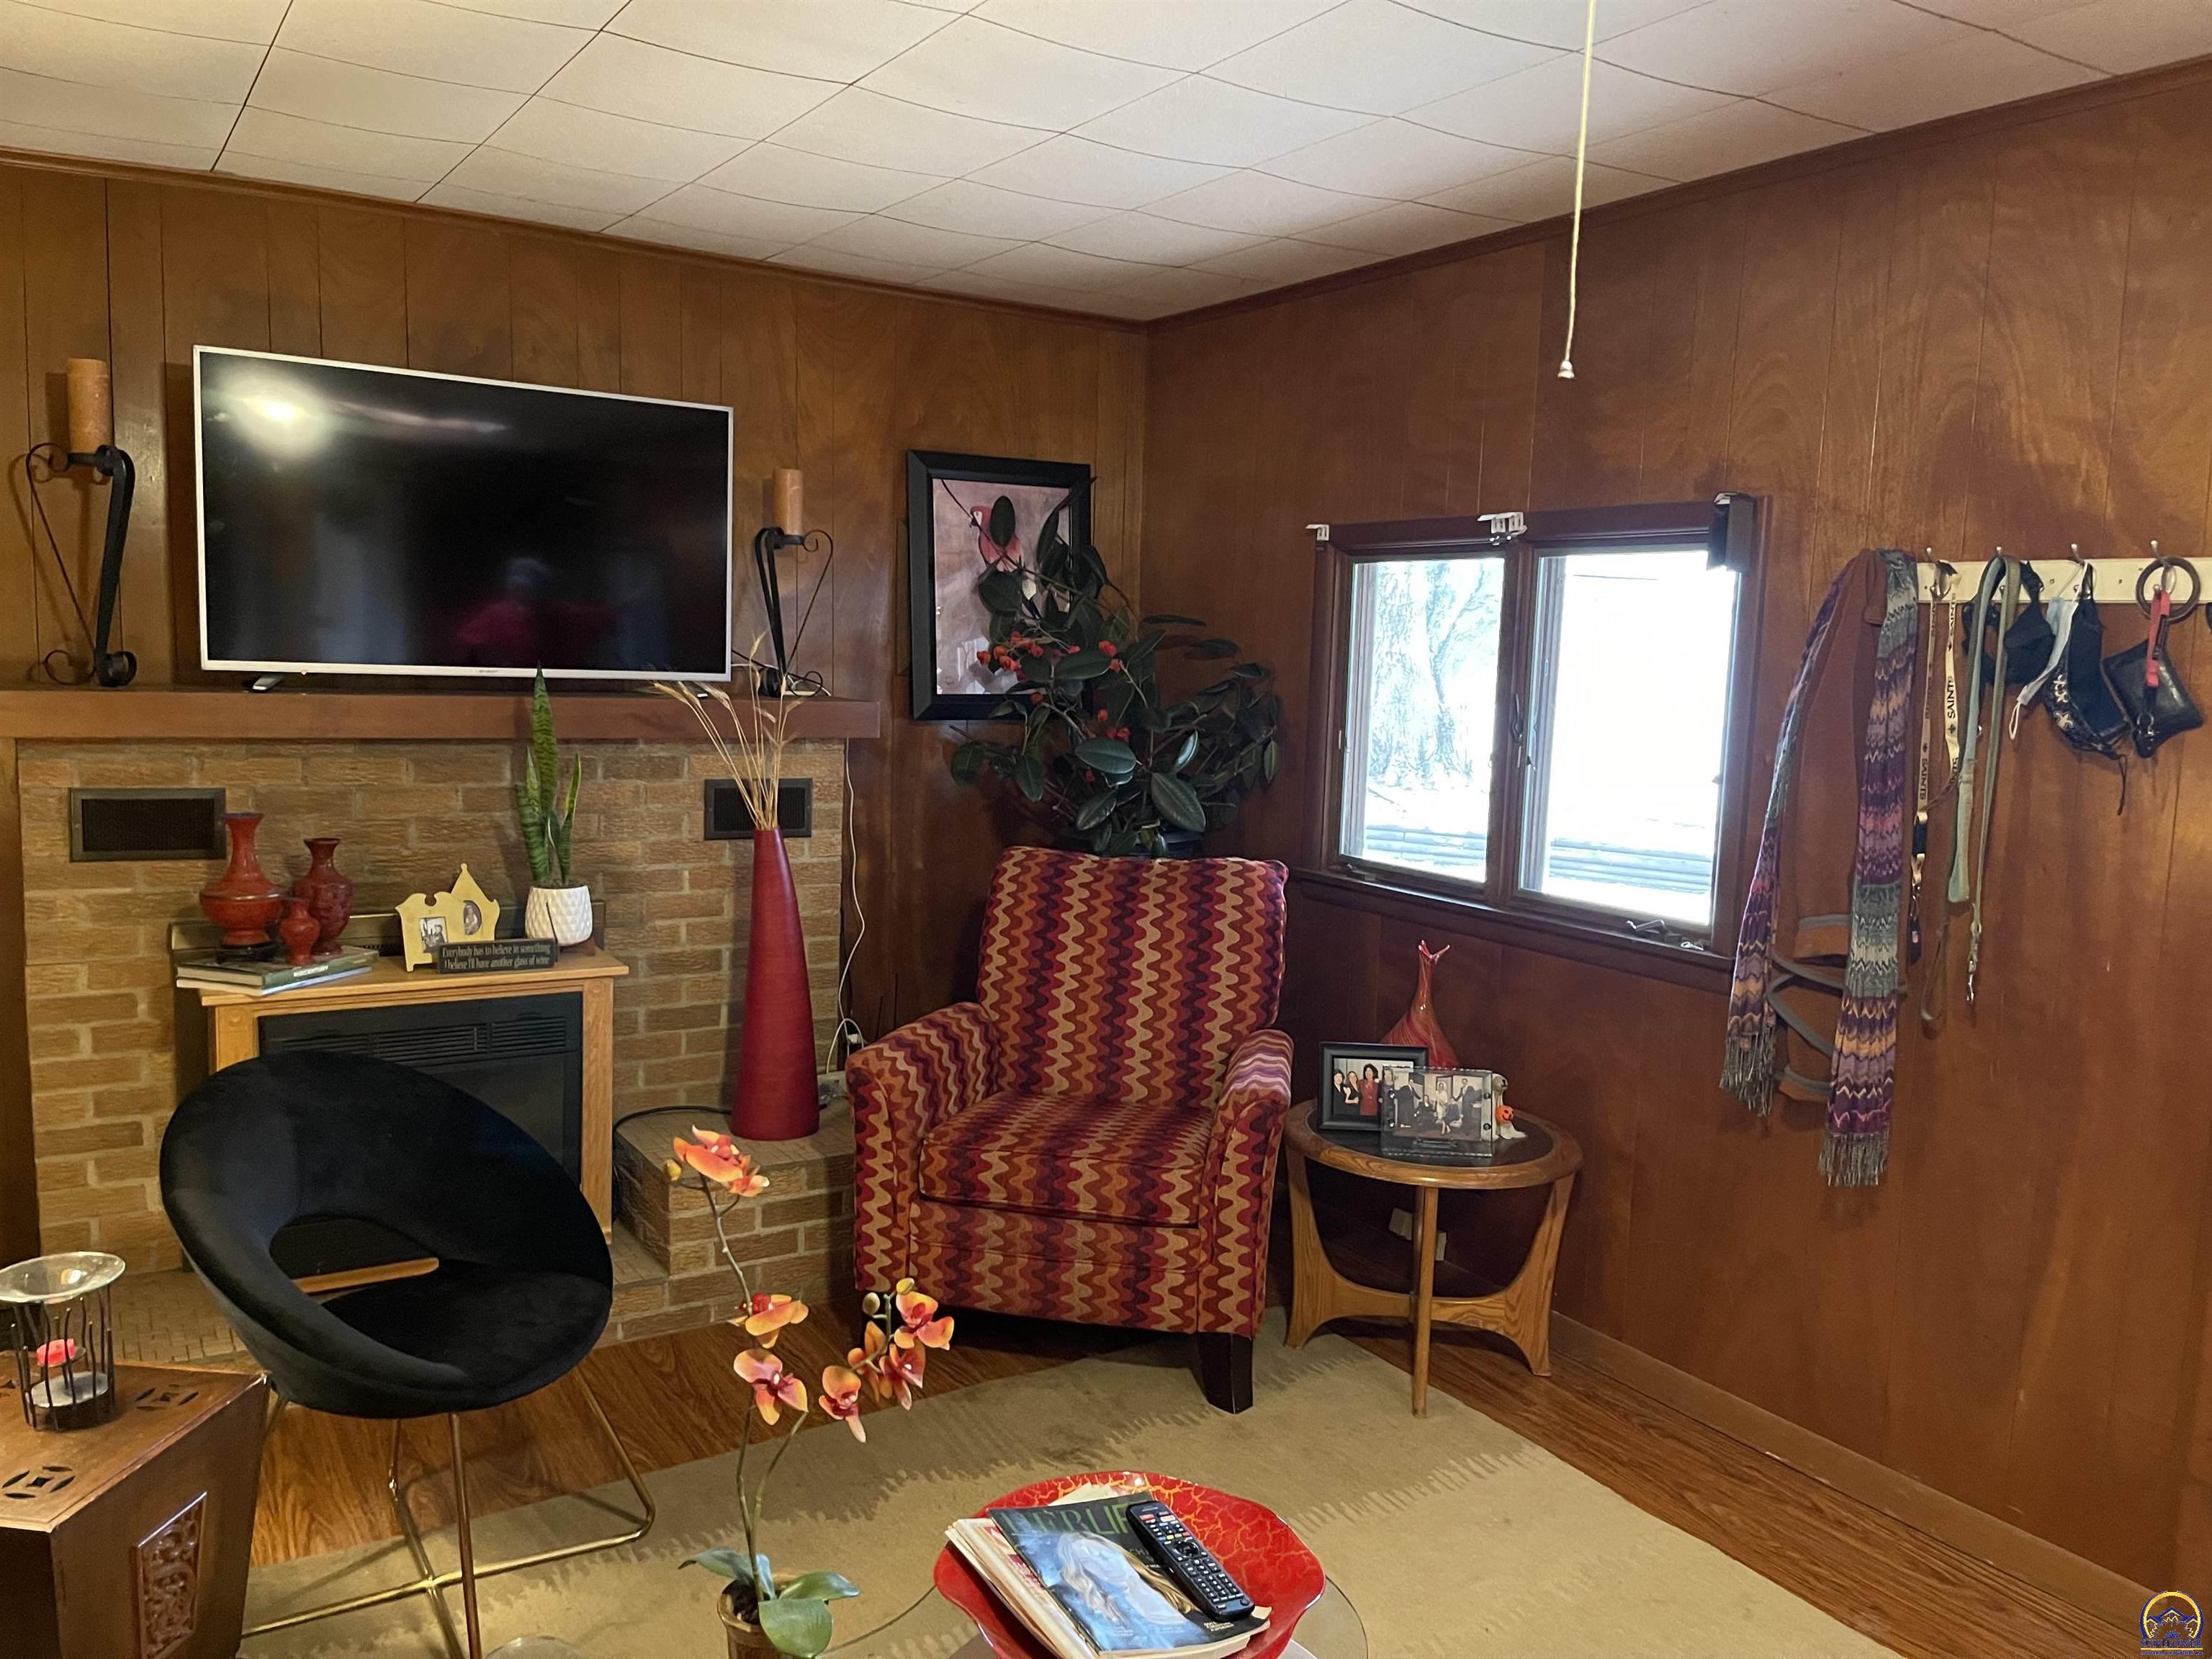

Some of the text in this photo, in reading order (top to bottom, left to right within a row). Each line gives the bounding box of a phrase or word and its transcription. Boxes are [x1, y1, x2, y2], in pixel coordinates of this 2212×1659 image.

[1947, 675, 1956, 719] SAINTS
[1920, 759, 1928, 800] SAINTS
[443, 943, 550, 958] Everybody has to believe in something
[448, 958, 468, 969] believe
[476, 958, 489, 968] have
[490, 956, 513, 967] another
[514, 956, 528, 968] glass
[529, 956, 535, 965] of
[536, 956, 549, 964] wine
